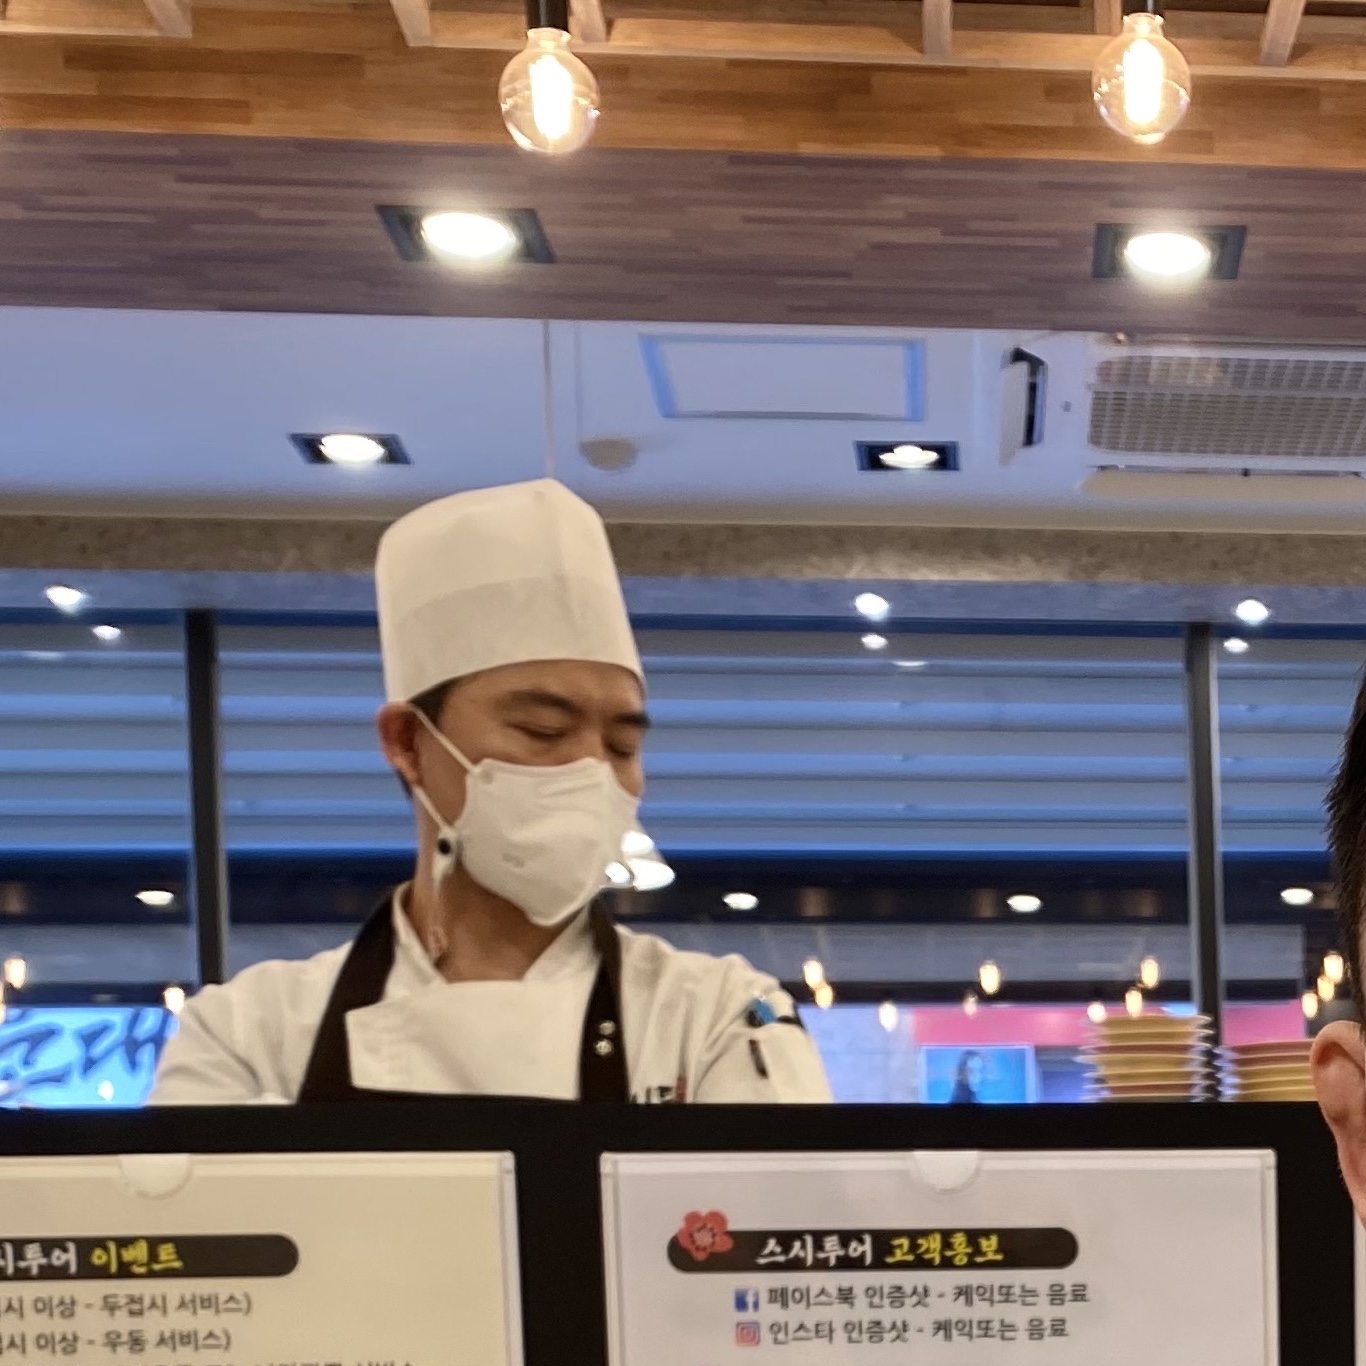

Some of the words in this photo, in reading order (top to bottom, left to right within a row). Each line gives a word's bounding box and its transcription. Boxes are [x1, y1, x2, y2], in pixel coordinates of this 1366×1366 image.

[89, 1238, 184, 1276] 이벤트
[755, 1234, 874, 1267] 스시투어
[884, 1232, 1004, 1266] 고객홍보
[33, 1294, 77, 1320] 이상
[177, 1291, 253, 1317] 서비스)
[767, 1285, 855, 1311] 페이스북
[864, 1284, 930, 1308] 인증샷
[952, 1283, 1039, 1307] 케익또는
[1046, 1282, 1090, 1304] 음료
[35, 1330, 80, 1357] 이상
[103, 1329, 146, 1354] 우동
[156, 1327, 232, 1352] 서비스)
[769, 1320, 836, 1344] 인스타
[843, 1319, 910, 1344] 인증샷
[931, 1318, 1019, 1341] 케익또는
[1025, 1317, 1069, 1340] 음료
